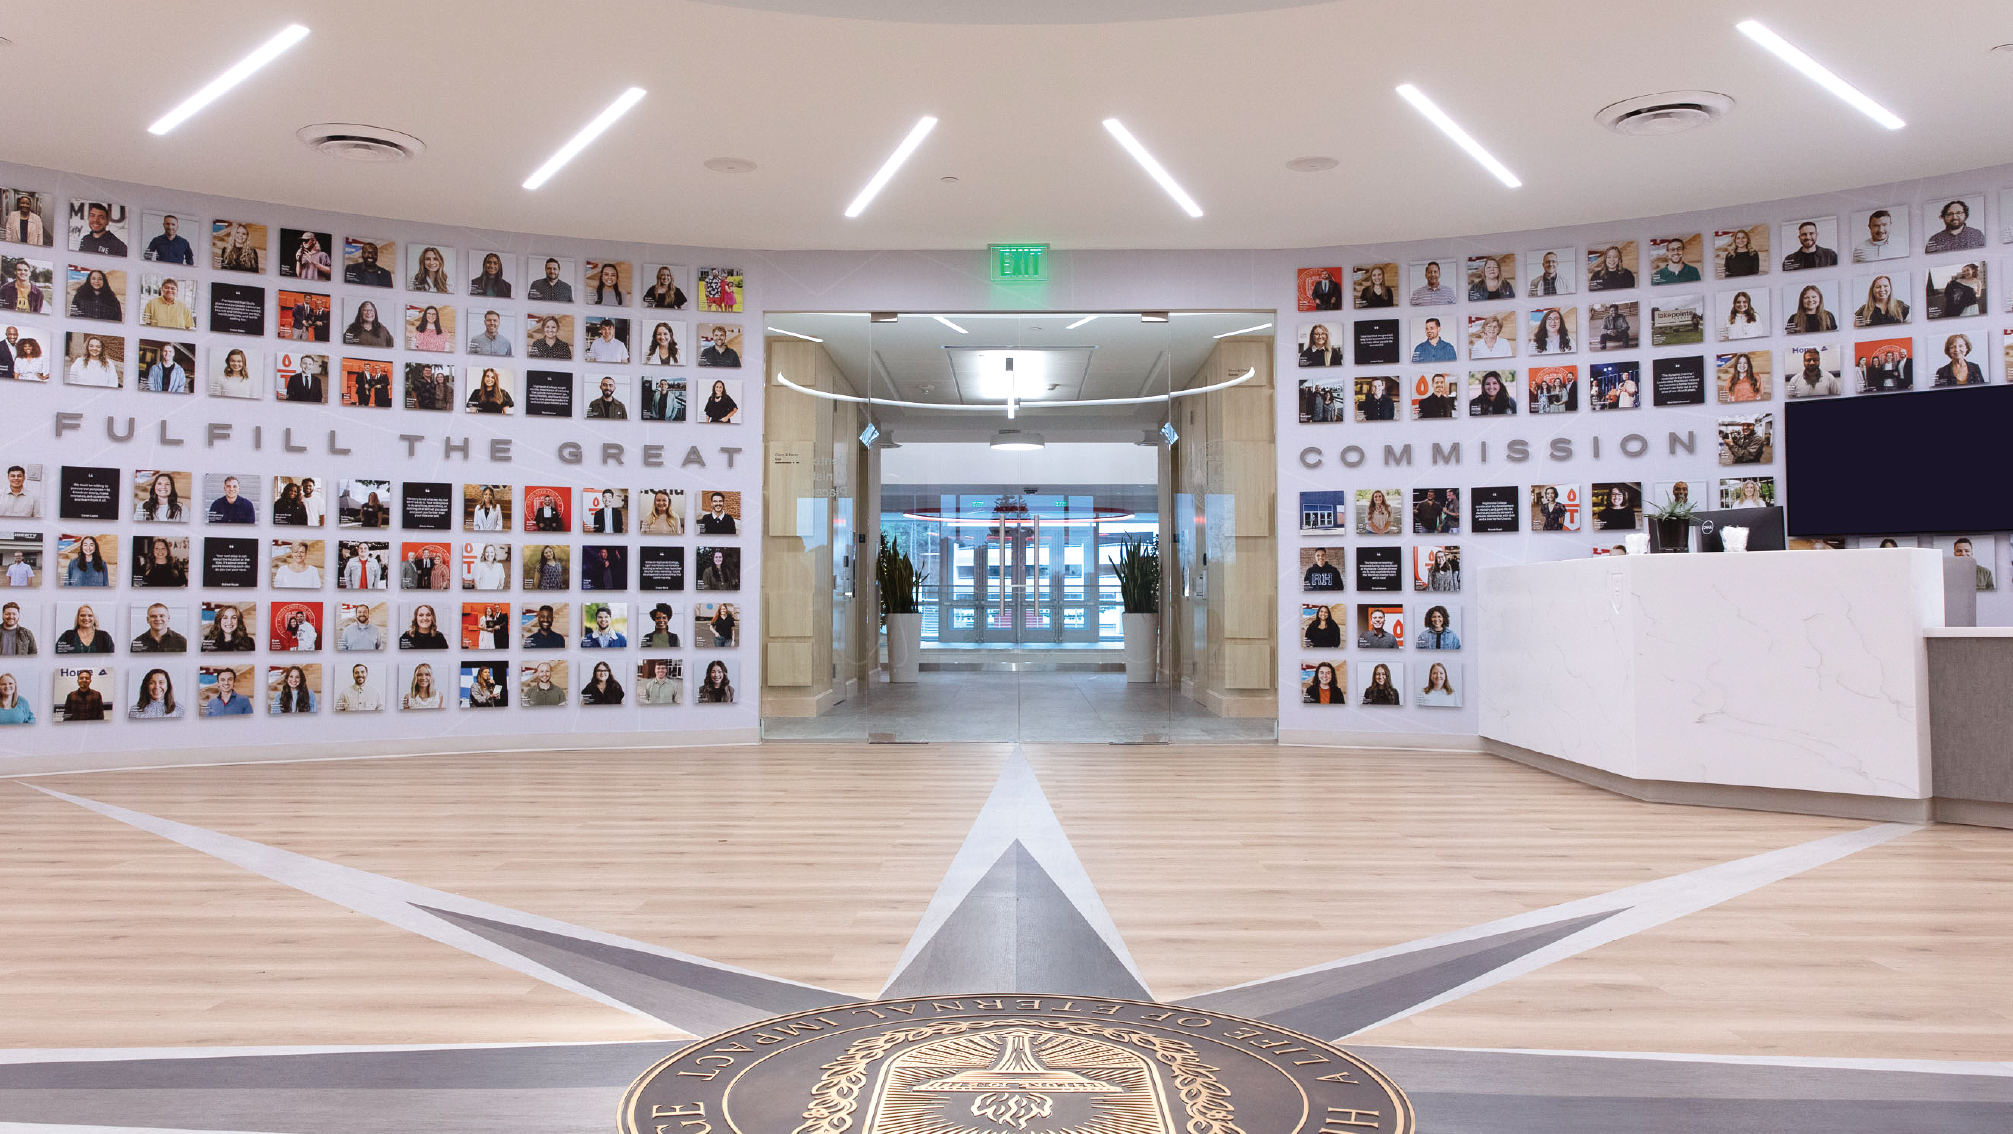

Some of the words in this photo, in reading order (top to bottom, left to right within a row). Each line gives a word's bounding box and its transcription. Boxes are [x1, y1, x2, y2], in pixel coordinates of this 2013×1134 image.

[70, 203, 125, 223] MU
[1000, 249, 1042, 277] EXIT
[55, 411, 351, 453] FULFILL
[399, 433, 512, 461] THE
[558, 441, 742, 469] GREAT
[1300, 430, 1695, 468] COMMISSION
[1312, 573, 1333, 586] RH
[852, 999, 1124, 1019] ETERNAL
[1140, 1011, 1212, 1027] OF
[677, 1016, 840, 1081] IMPACT
[1223, 1027, 1331, 1065] LIFE
[1315, 1071, 1359, 1084] A
